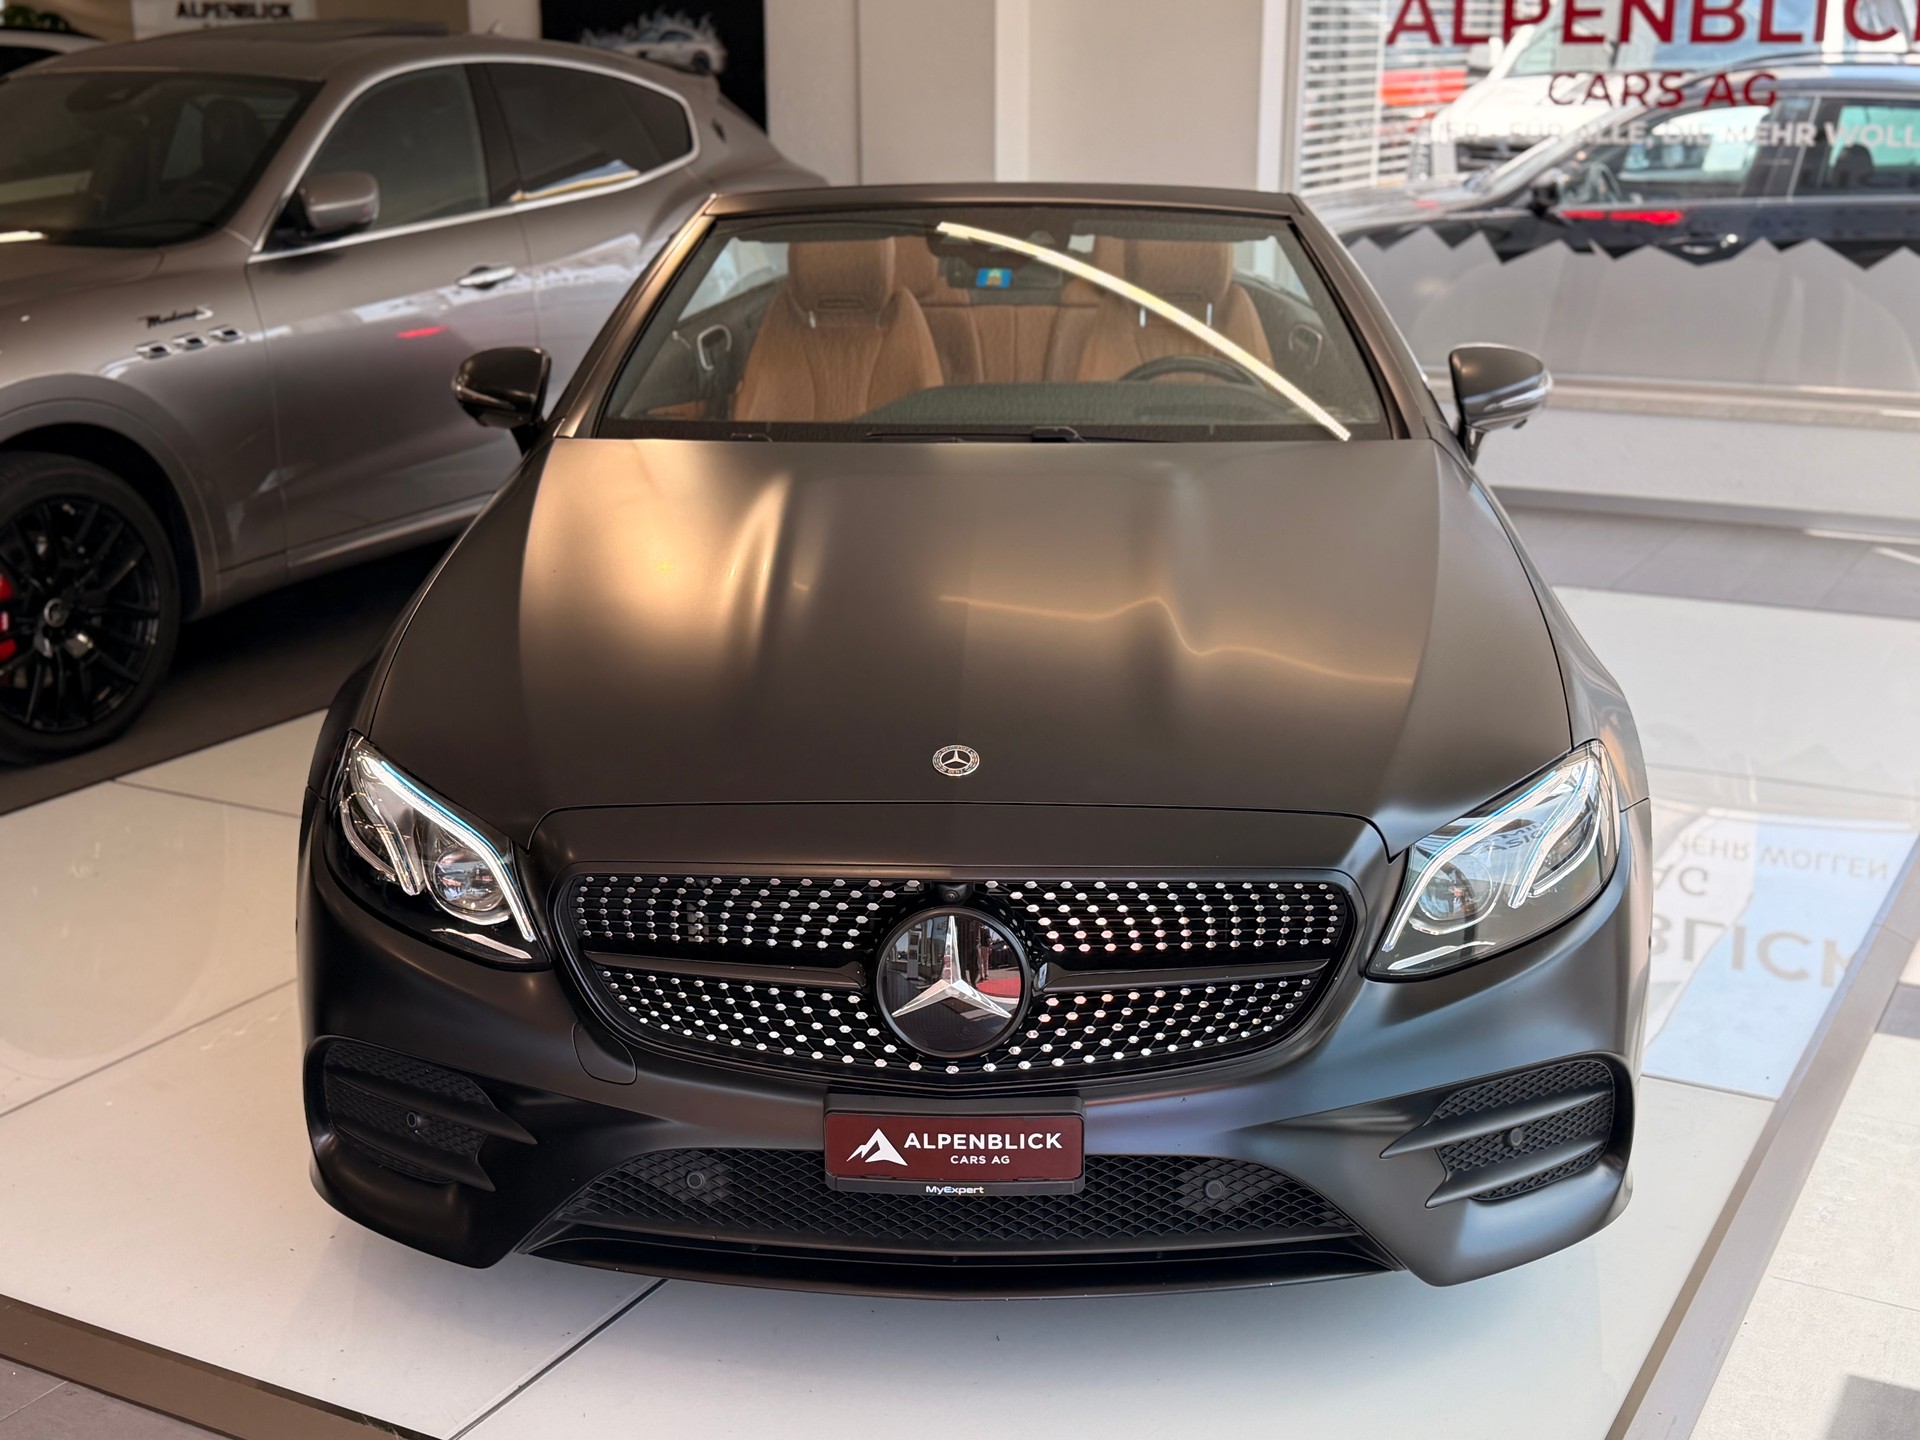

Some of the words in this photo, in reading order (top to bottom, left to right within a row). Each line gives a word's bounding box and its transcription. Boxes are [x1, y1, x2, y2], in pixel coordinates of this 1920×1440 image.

[1548, 72, 1683, 109] CARS
[1704, 72, 1777, 109] AG
[1725, 121, 1817, 147] MEHR
[903, 1132, 1063, 1150] ALPENBLICK
[950, 1155, 987, 1165] CARS
[991, 1155, 1010, 1165] AG
[925, 1184, 985, 1196] MyExpert
